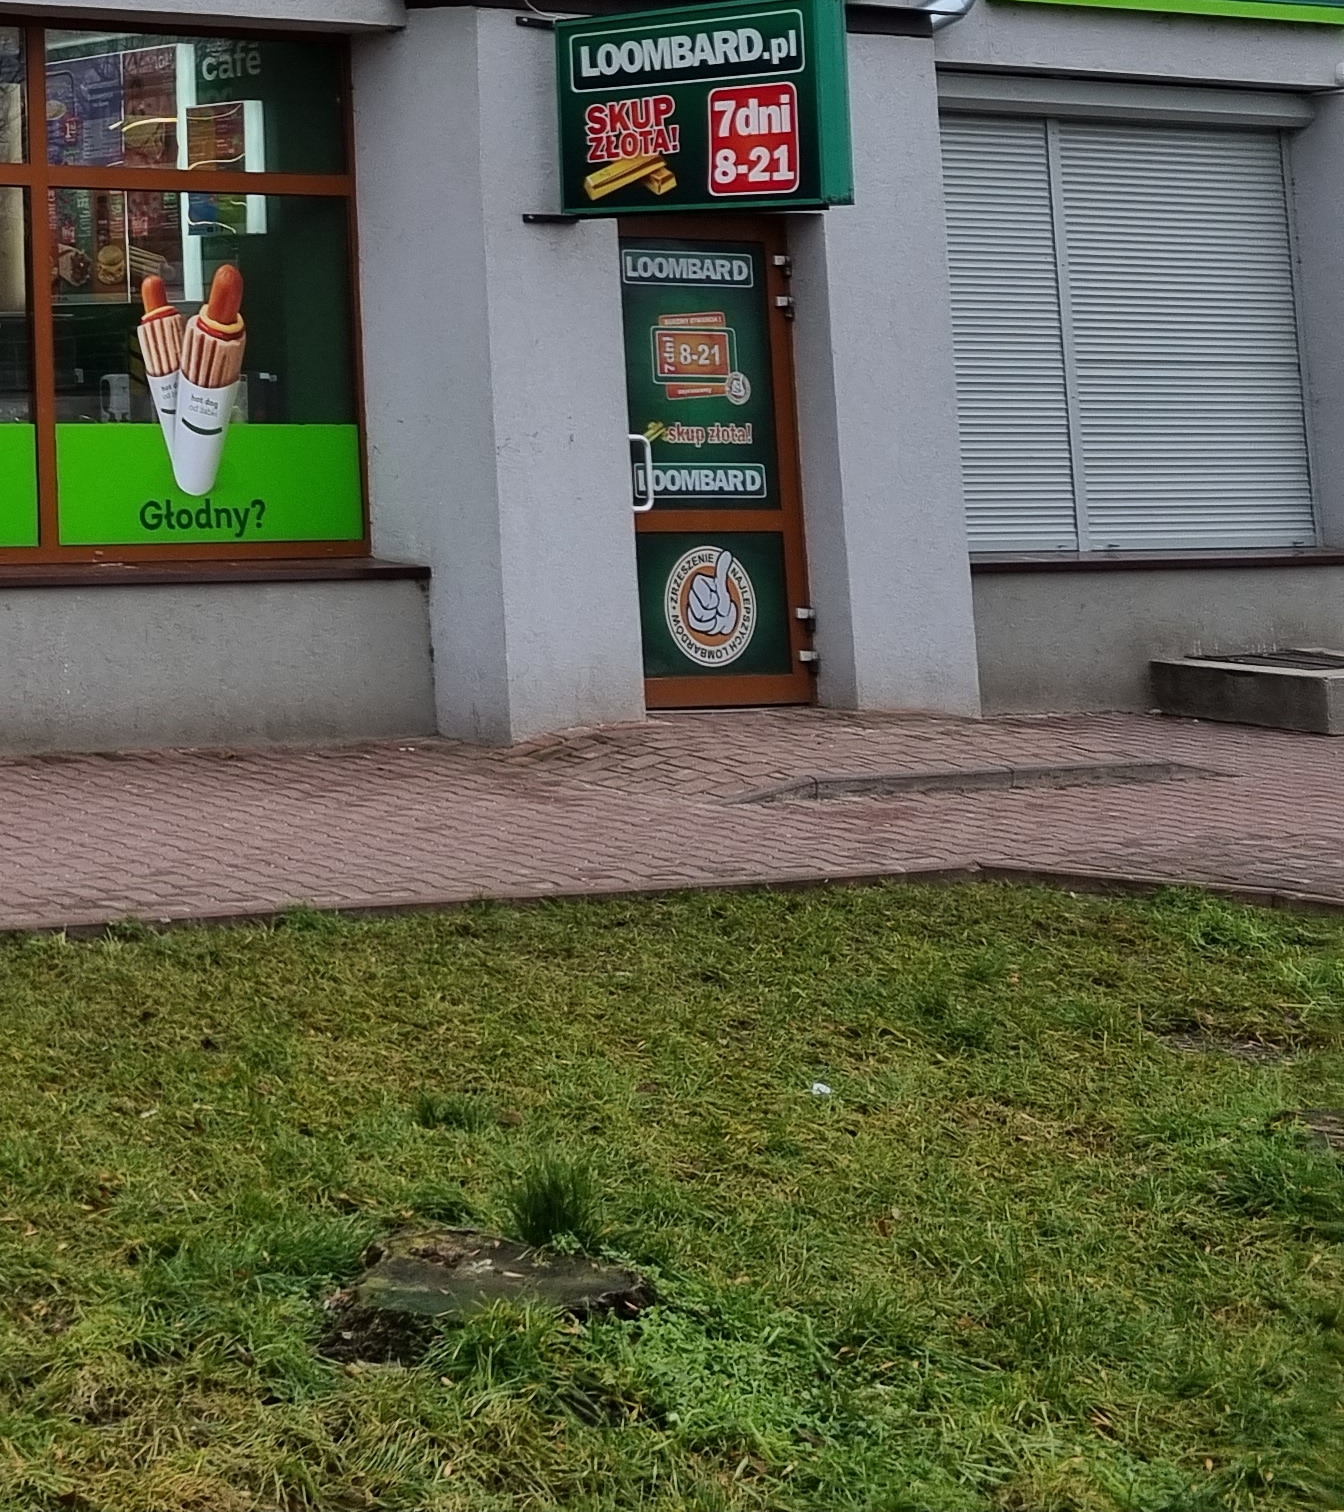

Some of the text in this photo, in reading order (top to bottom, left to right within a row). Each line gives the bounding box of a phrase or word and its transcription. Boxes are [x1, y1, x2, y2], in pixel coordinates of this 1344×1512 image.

[580, 28, 798, 78] LOOMBARD.pl
[585, 95, 675, 134] SKUP
[715, 97, 791, 138] 7dni
[586, 123, 680, 163] ZŁOTA!
[715, 145, 795, 184] 8-21
[625, 257, 749, 282] LOOMBARD
[679, 343, 720, 366] 8-21
[667, 421, 753, 448] skup złota!
[139, 498, 266, 538] Głodny?
[670, 553, 752, 660] ZRZESZENIE NAJLEPSZYCH LOMBARDÓW
